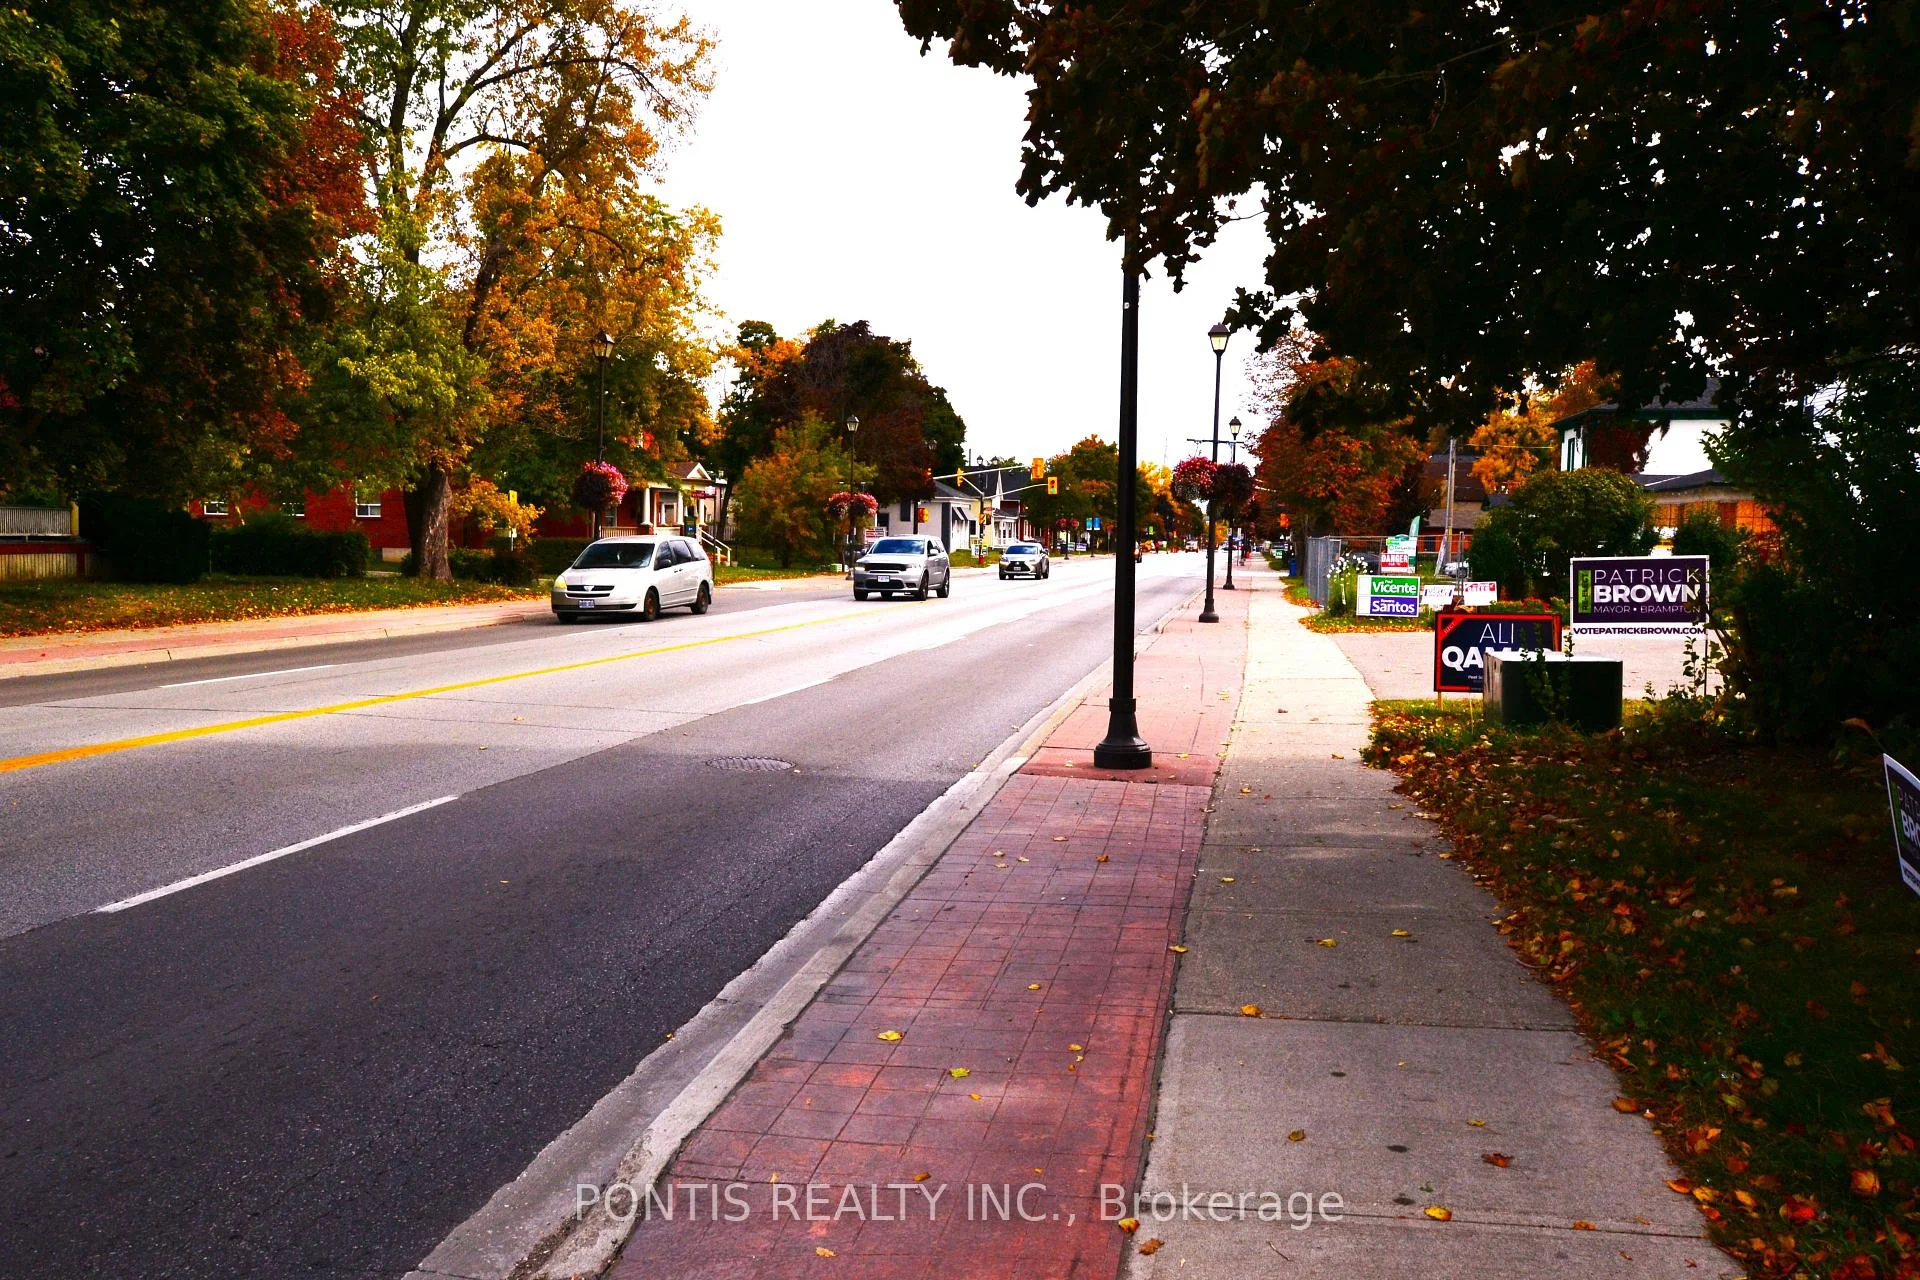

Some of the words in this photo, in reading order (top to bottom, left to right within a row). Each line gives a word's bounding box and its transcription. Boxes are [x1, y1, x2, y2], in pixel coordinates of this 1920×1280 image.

[1594, 568, 1700, 583] PATRICK
[1372, 581, 1416, 594] Vicente
[1593, 584, 1700, 603] BROWN
[1372, 600, 1415, 613] Santos
[1593, 605, 1631, 614] MAYOR
[1479, 622, 1514, 644] ALI
[1573, 627, 1706, 635] VOTEPATRICKBROWN.COM
